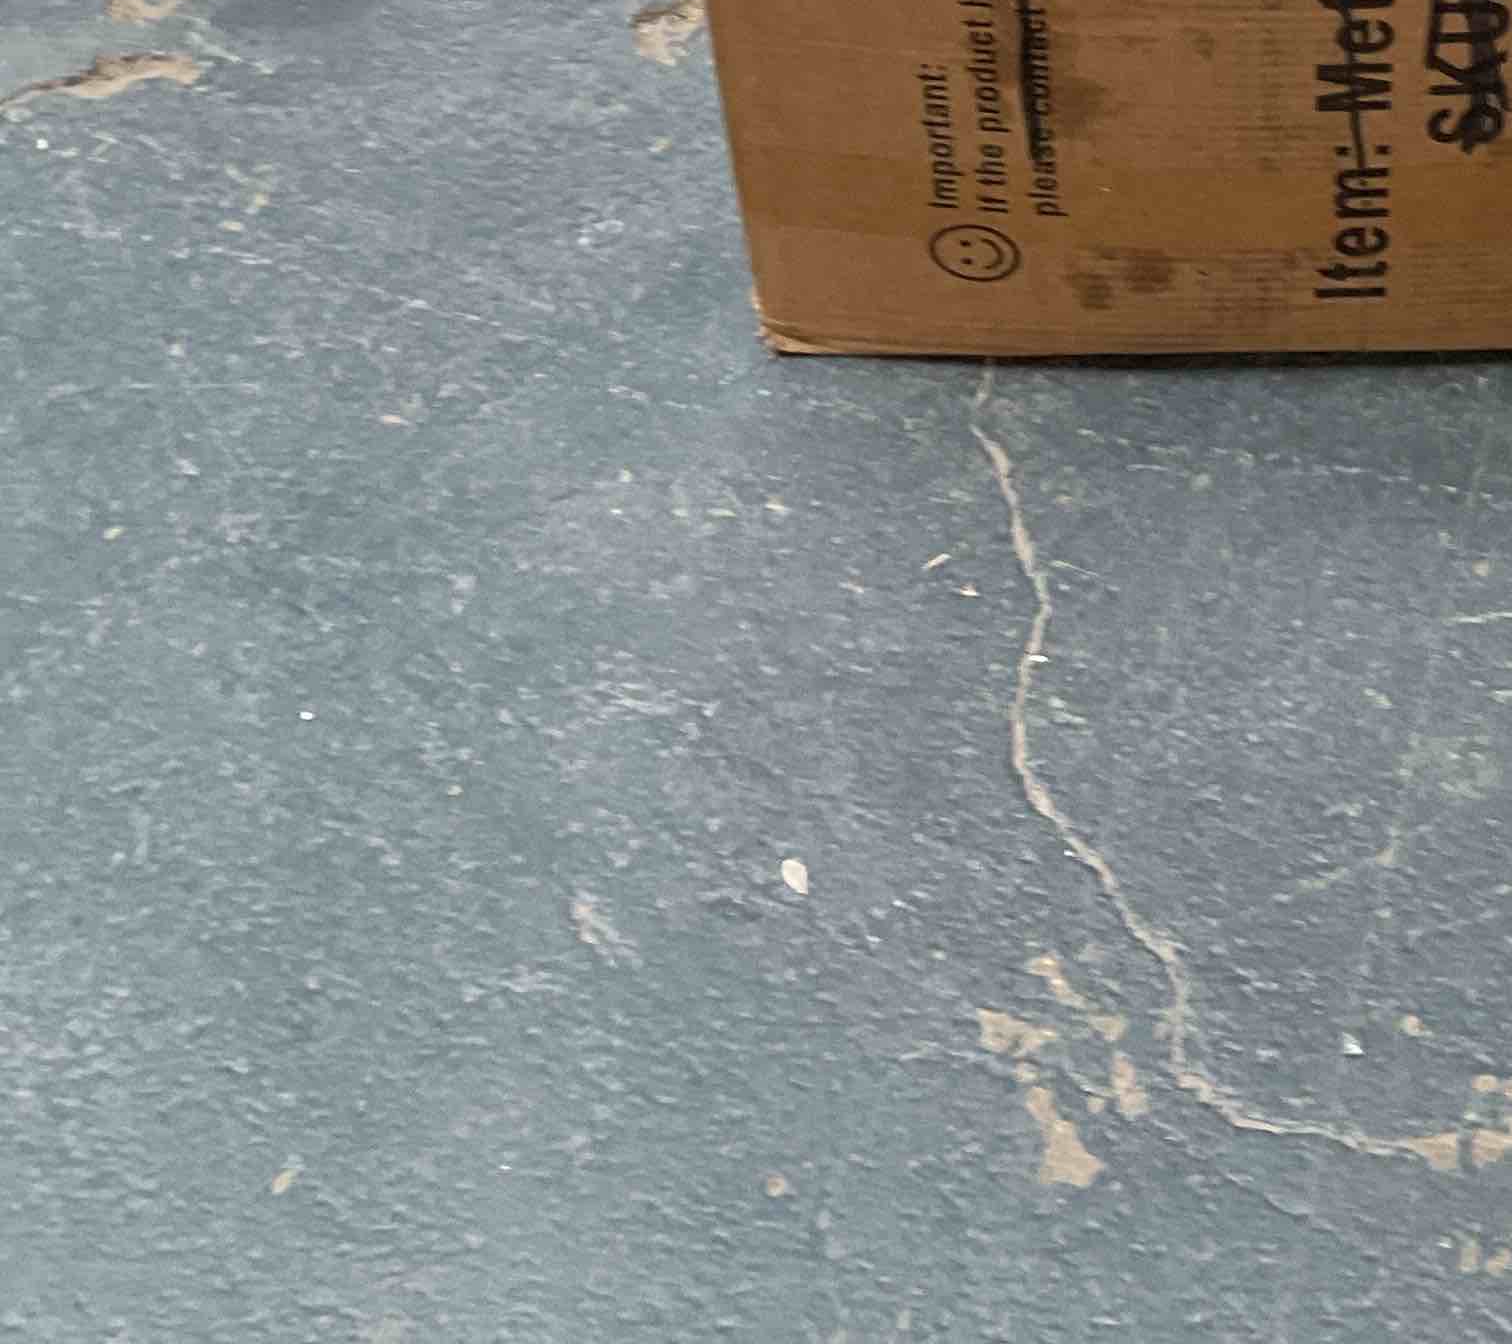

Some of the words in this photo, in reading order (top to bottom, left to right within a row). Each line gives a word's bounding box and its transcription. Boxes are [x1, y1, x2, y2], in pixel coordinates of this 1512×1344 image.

[966, 19, 1008, 134] product
[1017, 7, 1051, 116] contact
[917, 63, 960, 209] Important:
[972, 144, 1006, 187] the
[1025, 129, 1067, 217] please
[977, 193, 1008, 214] If
[1314, 146, 1390, 300] Item:
